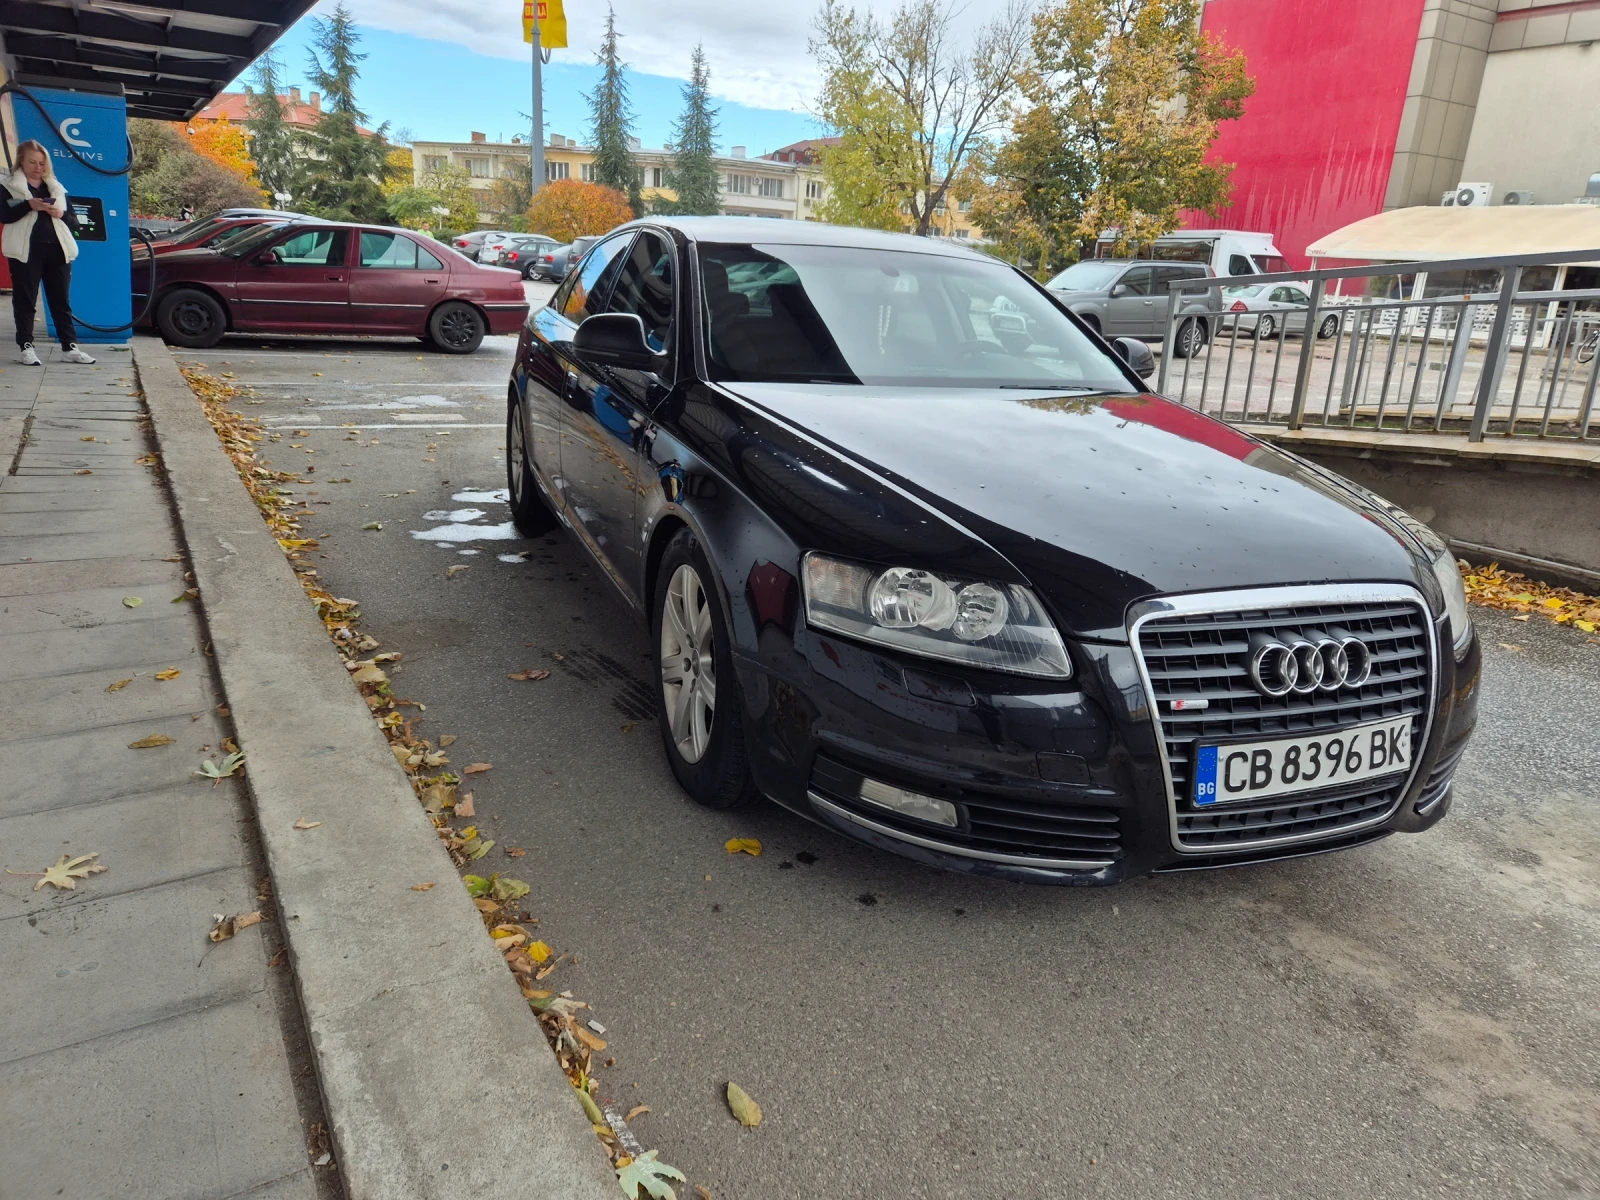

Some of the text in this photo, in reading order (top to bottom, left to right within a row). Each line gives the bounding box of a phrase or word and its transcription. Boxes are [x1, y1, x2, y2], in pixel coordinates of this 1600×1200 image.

[525, 5, 547, 16] BILA
[1224, 724, 1406, 793] CB 8396 BK
[1198, 782, 1214, 796] BG
